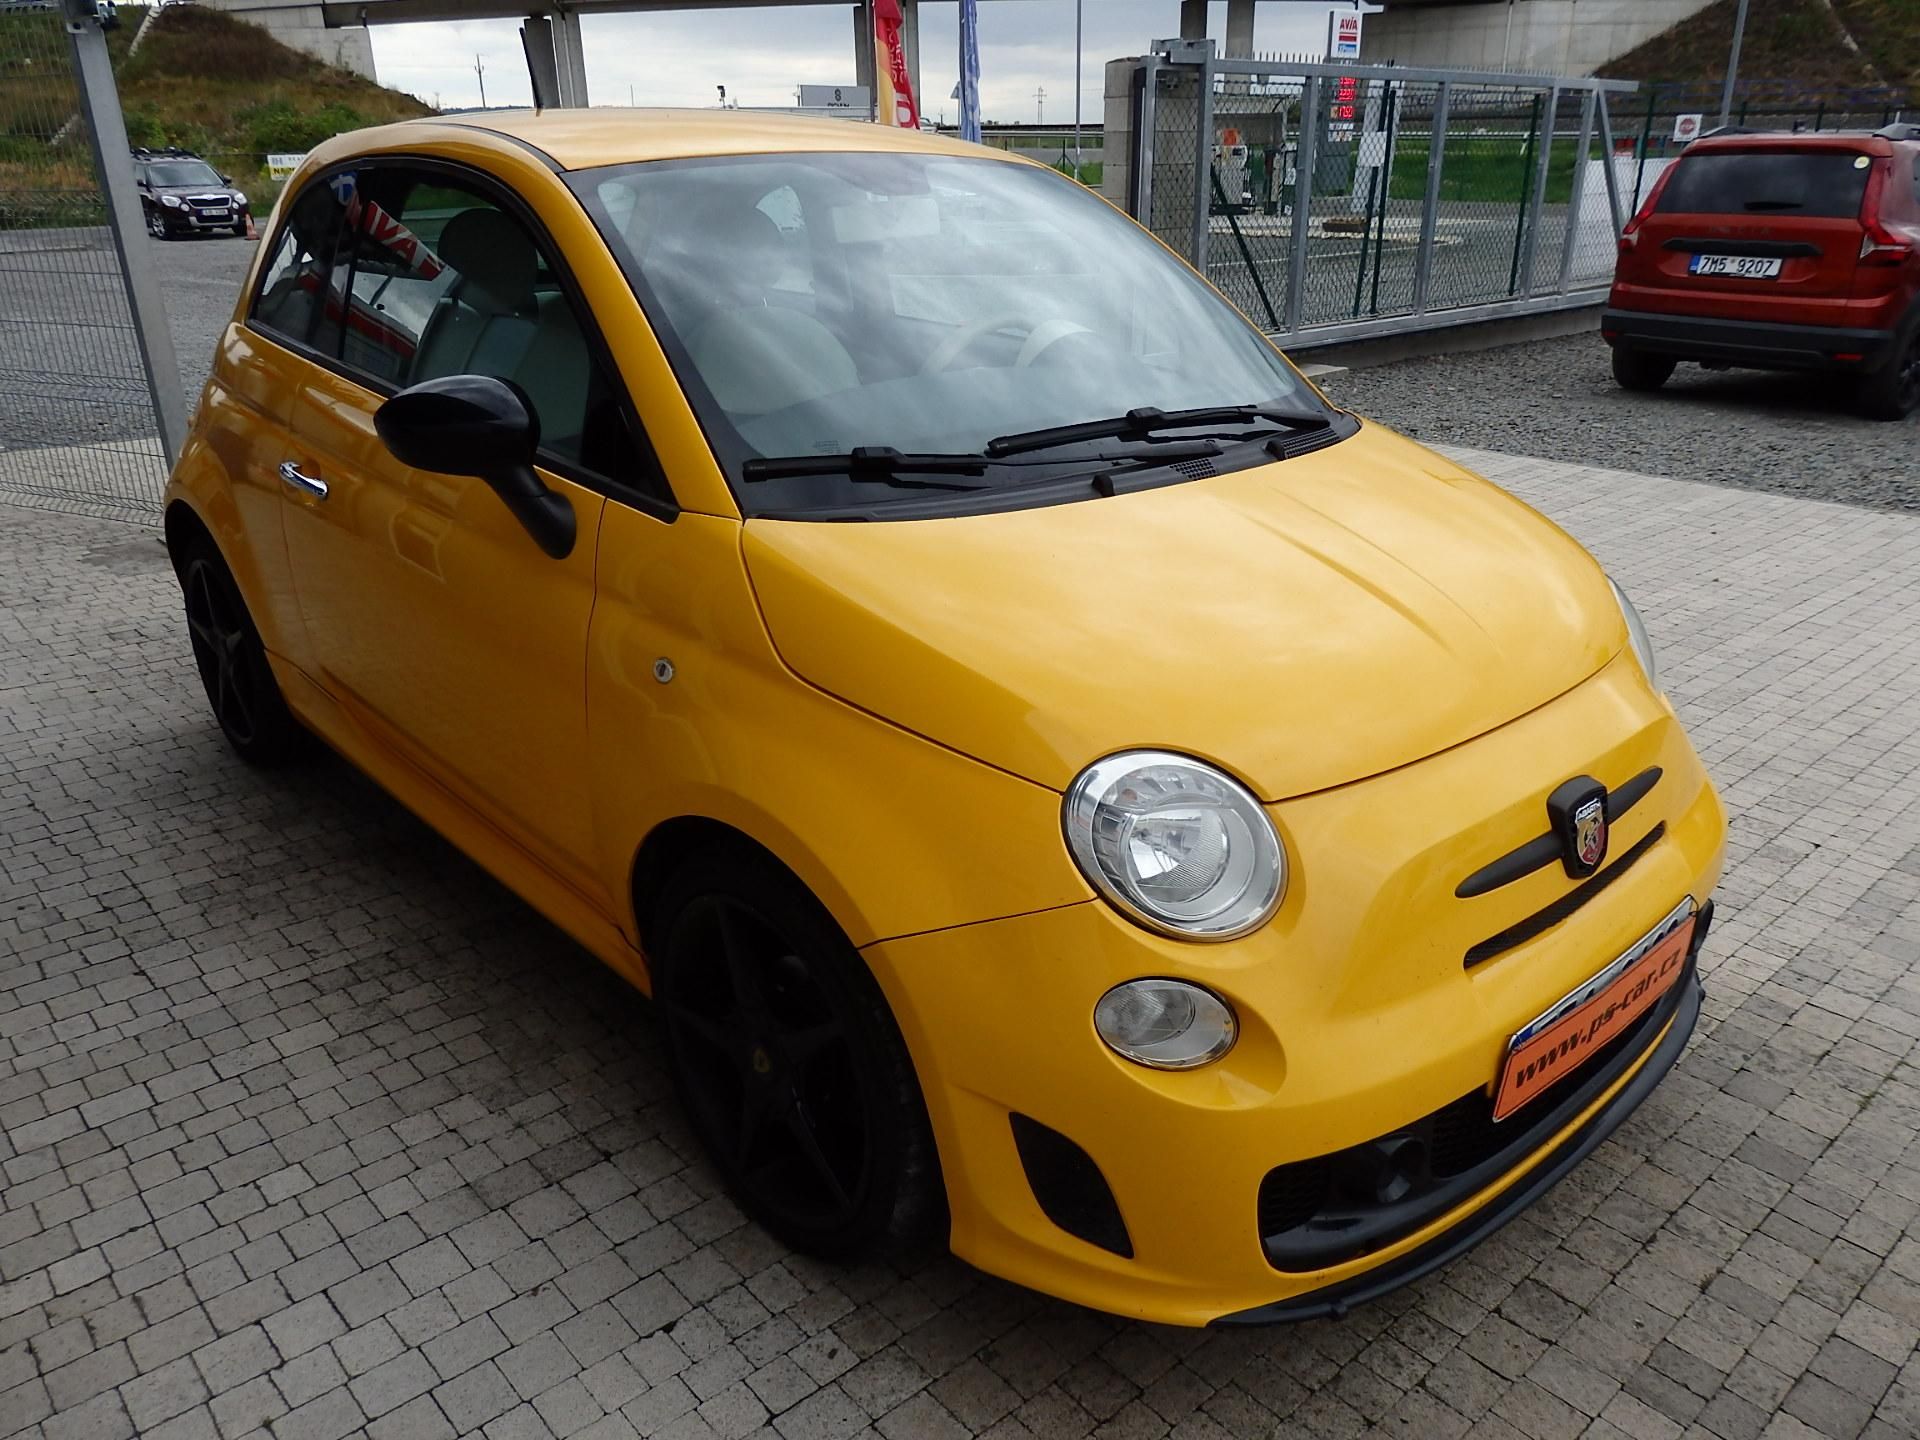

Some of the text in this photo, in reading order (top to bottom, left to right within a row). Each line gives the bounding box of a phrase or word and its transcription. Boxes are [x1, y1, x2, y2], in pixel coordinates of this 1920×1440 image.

[1700, 256, 1774, 274] 7M5 9207
[1515, 947, 1681, 1089] www.ps-car.cz
